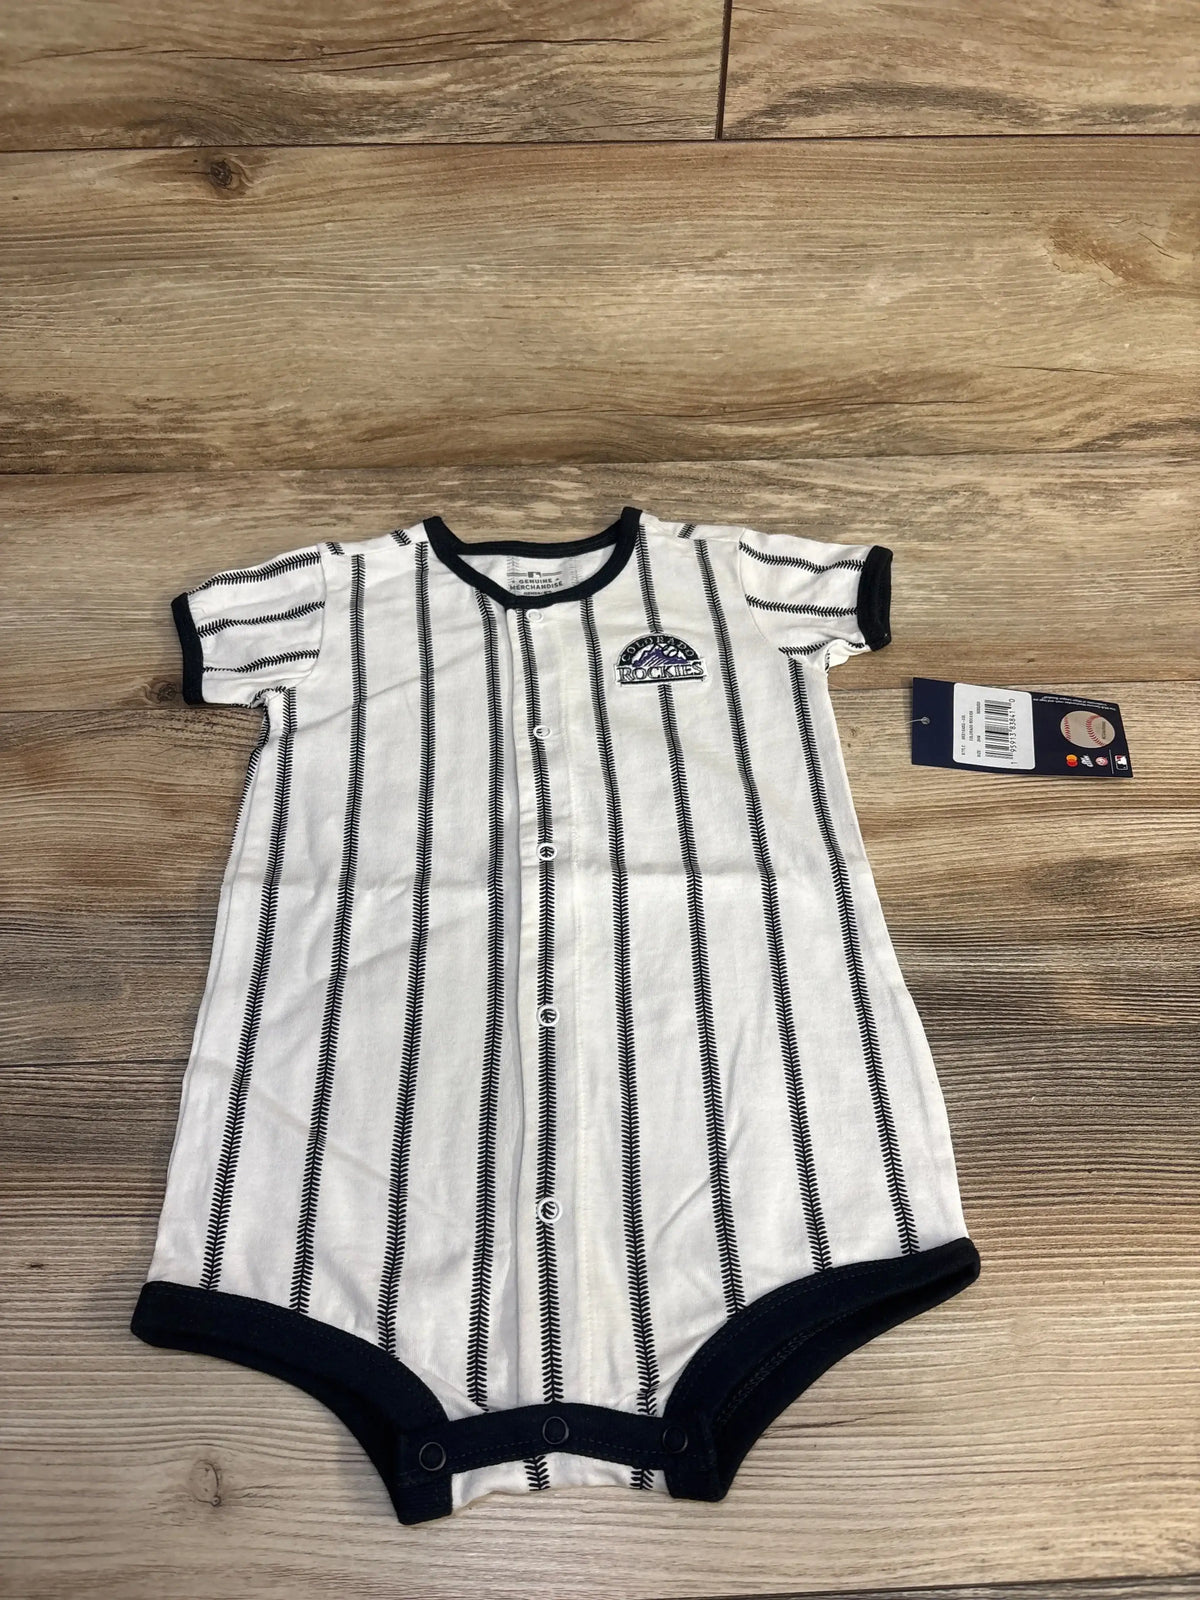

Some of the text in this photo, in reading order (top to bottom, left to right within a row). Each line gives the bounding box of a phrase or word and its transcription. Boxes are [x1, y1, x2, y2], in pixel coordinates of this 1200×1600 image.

[509, 580, 563, 591] MERCHANDISE
[621, 636, 695, 662] COLORADO
[616, 661, 704, 682] ROCKIES
[1009, 732, 1018, 753] 95913
